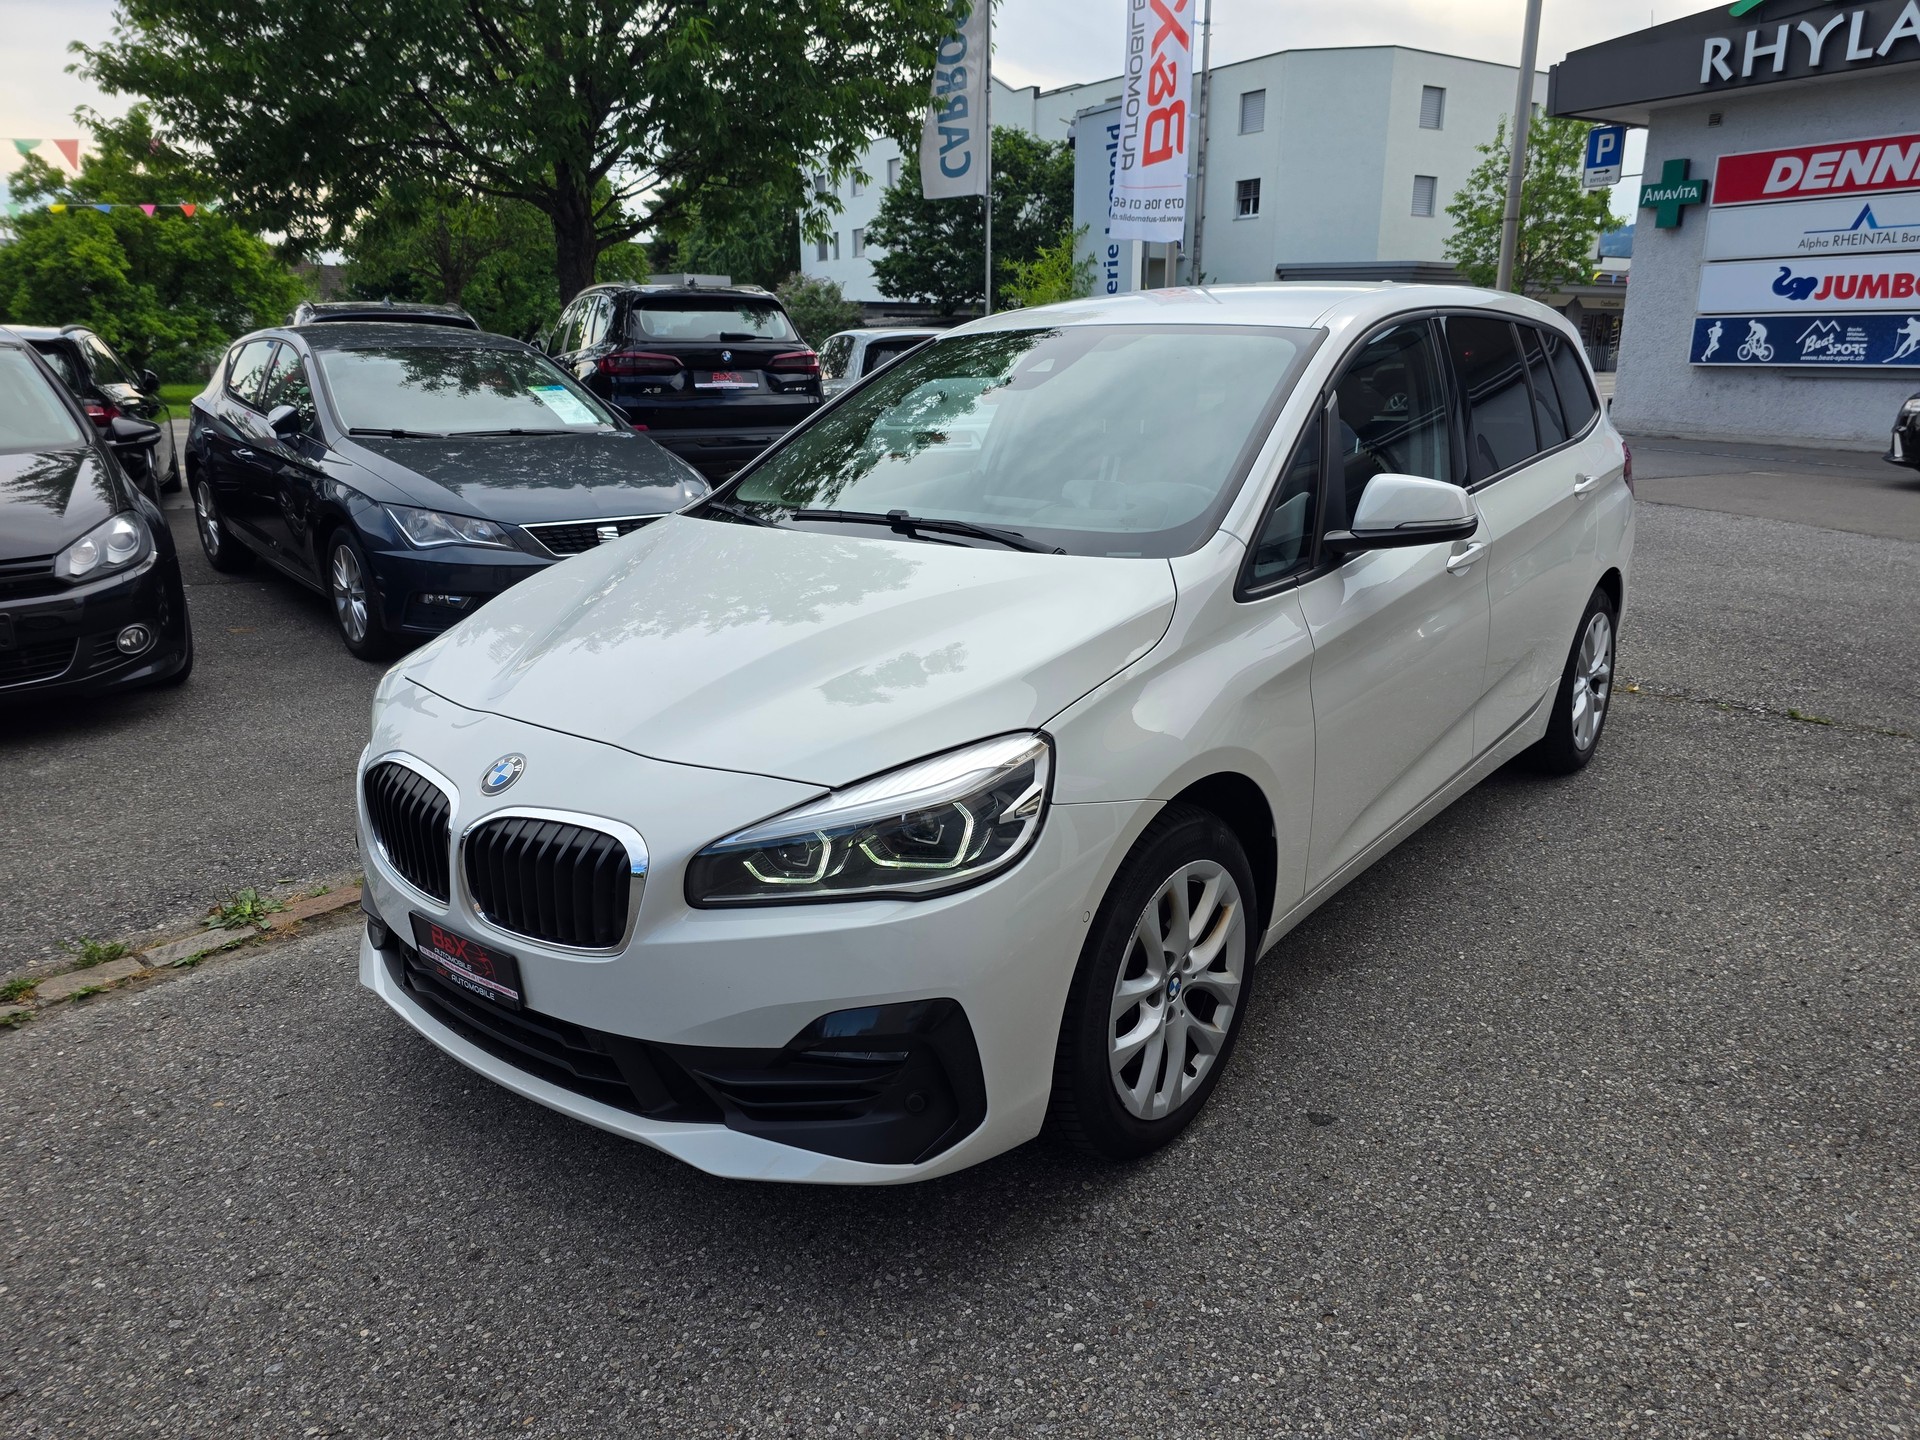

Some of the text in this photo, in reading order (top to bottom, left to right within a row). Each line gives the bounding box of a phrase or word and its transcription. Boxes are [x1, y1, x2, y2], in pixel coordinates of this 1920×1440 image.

[1700, 0, 1920, 84] RHYLA
[1596, 133, 1615, 164] P
[1762, 142, 1920, 194] DENN
[1798, 238, 1829, 251] Alpha
[1832, 231, 1899, 247] RHEINTAL
[1802, 333, 1835, 355] Beat
[432, 925, 468, 961] B&X
[434, 947, 473, 972] AUTOMOBILE
[451, 974, 495, 1000] AUTOMOBILE
